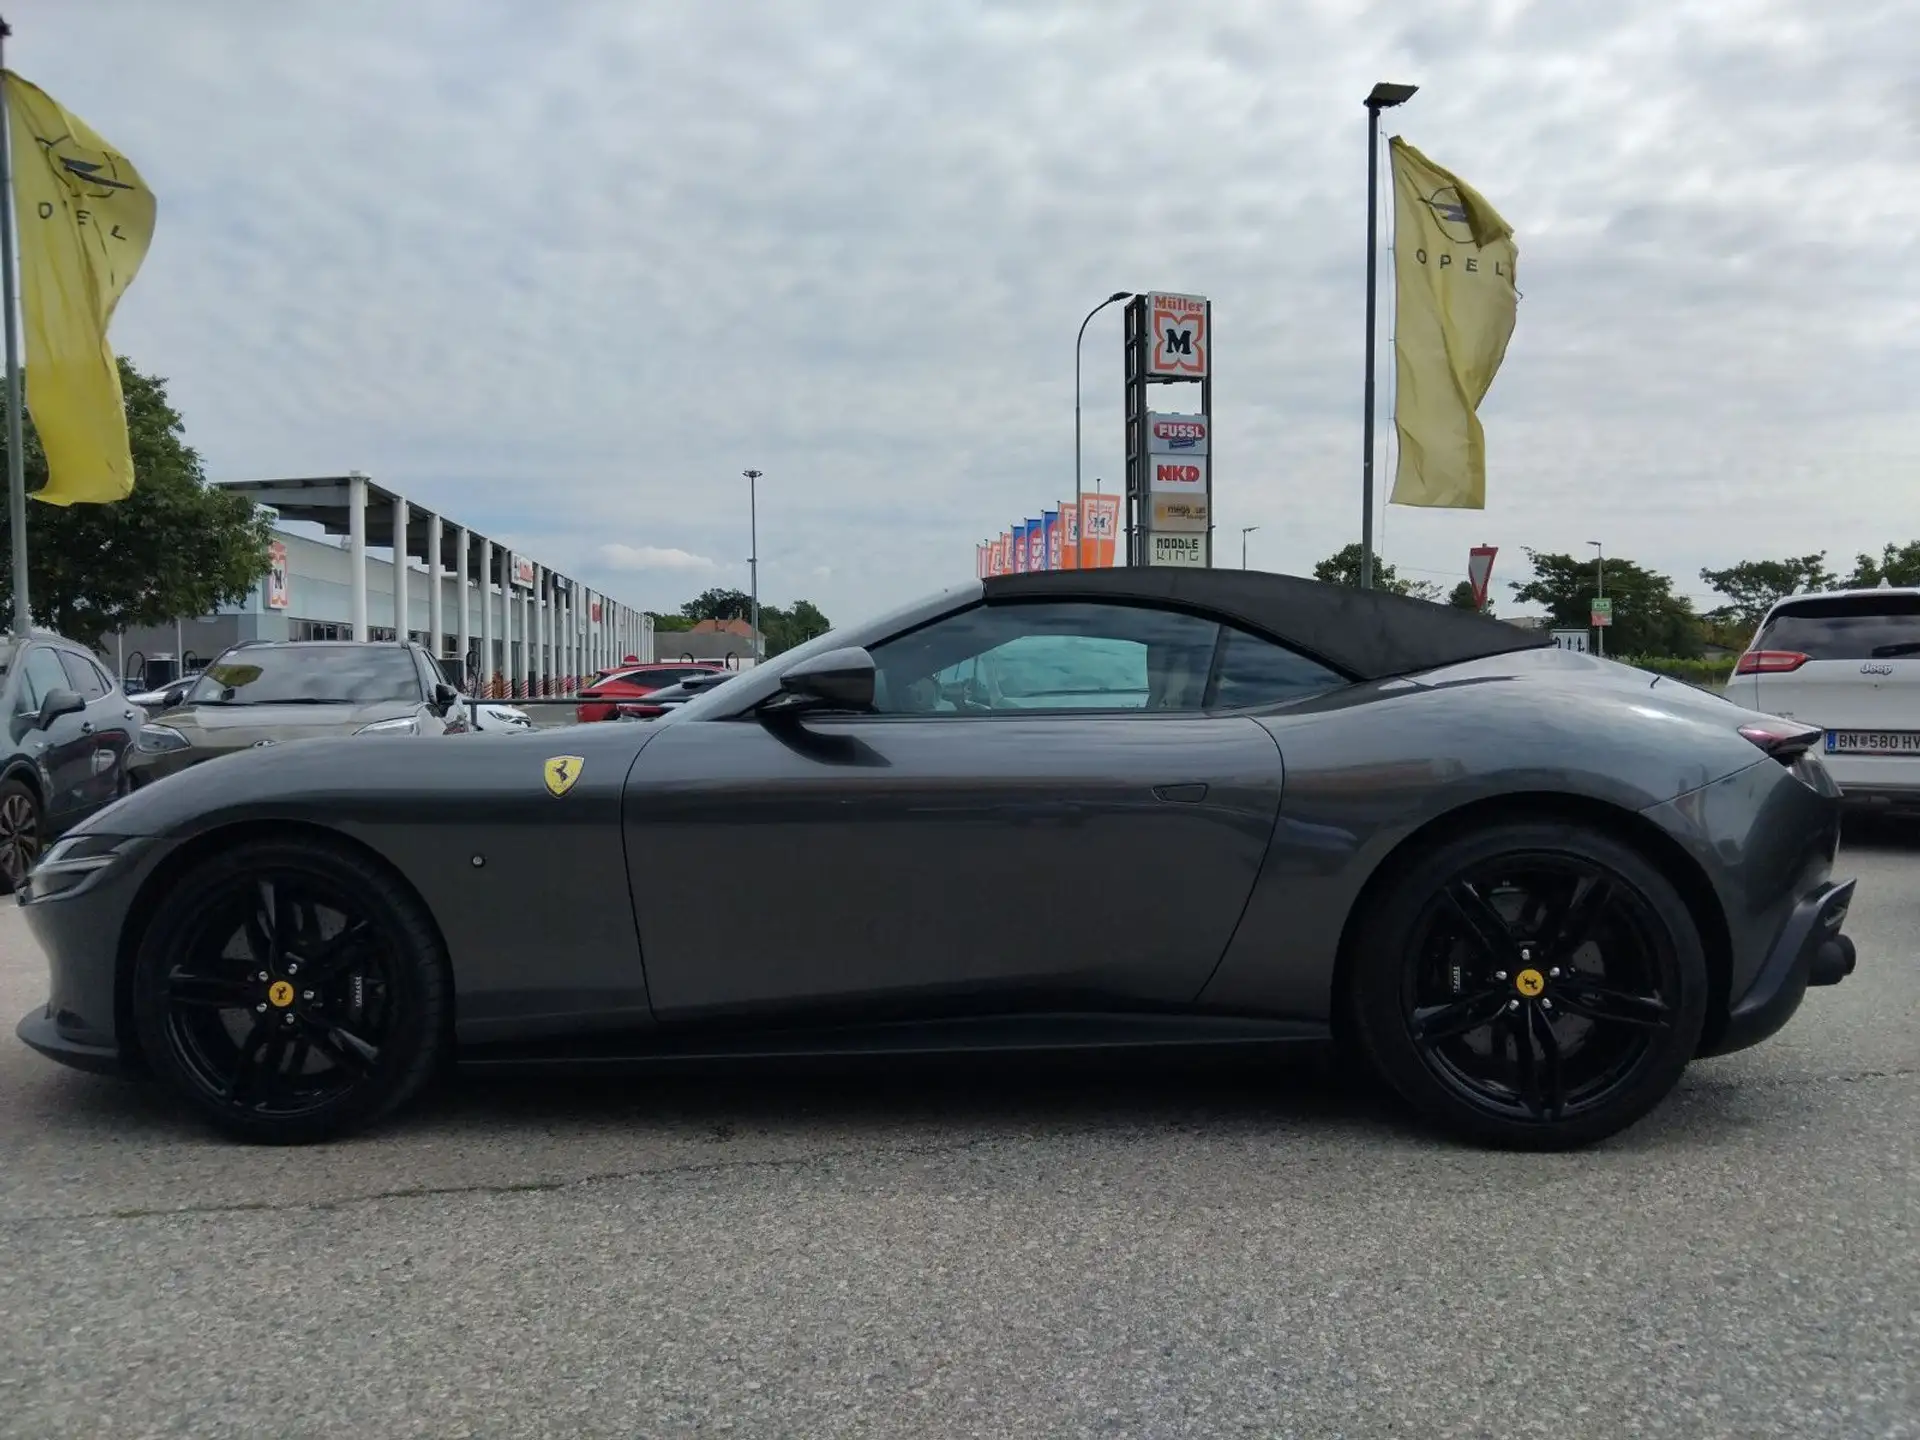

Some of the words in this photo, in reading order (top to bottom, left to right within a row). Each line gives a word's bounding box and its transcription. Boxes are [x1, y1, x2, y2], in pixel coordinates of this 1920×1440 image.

[38, 202, 127, 241] OEL
[1416, 248, 1504, 276] OPEL
[1154, 295, 1204, 312] Müller
[1166, 328, 1191, 354] M
[1159, 423, 1202, 438] FUSSL
[1156, 464, 1200, 482] NKD
[1156, 538, 1199, 549] NOODLE
[1860, 663, 1893, 675] Jeep
[1839, 735, 1858, 748] BN
[1869, 735, 1898, 748] 580
